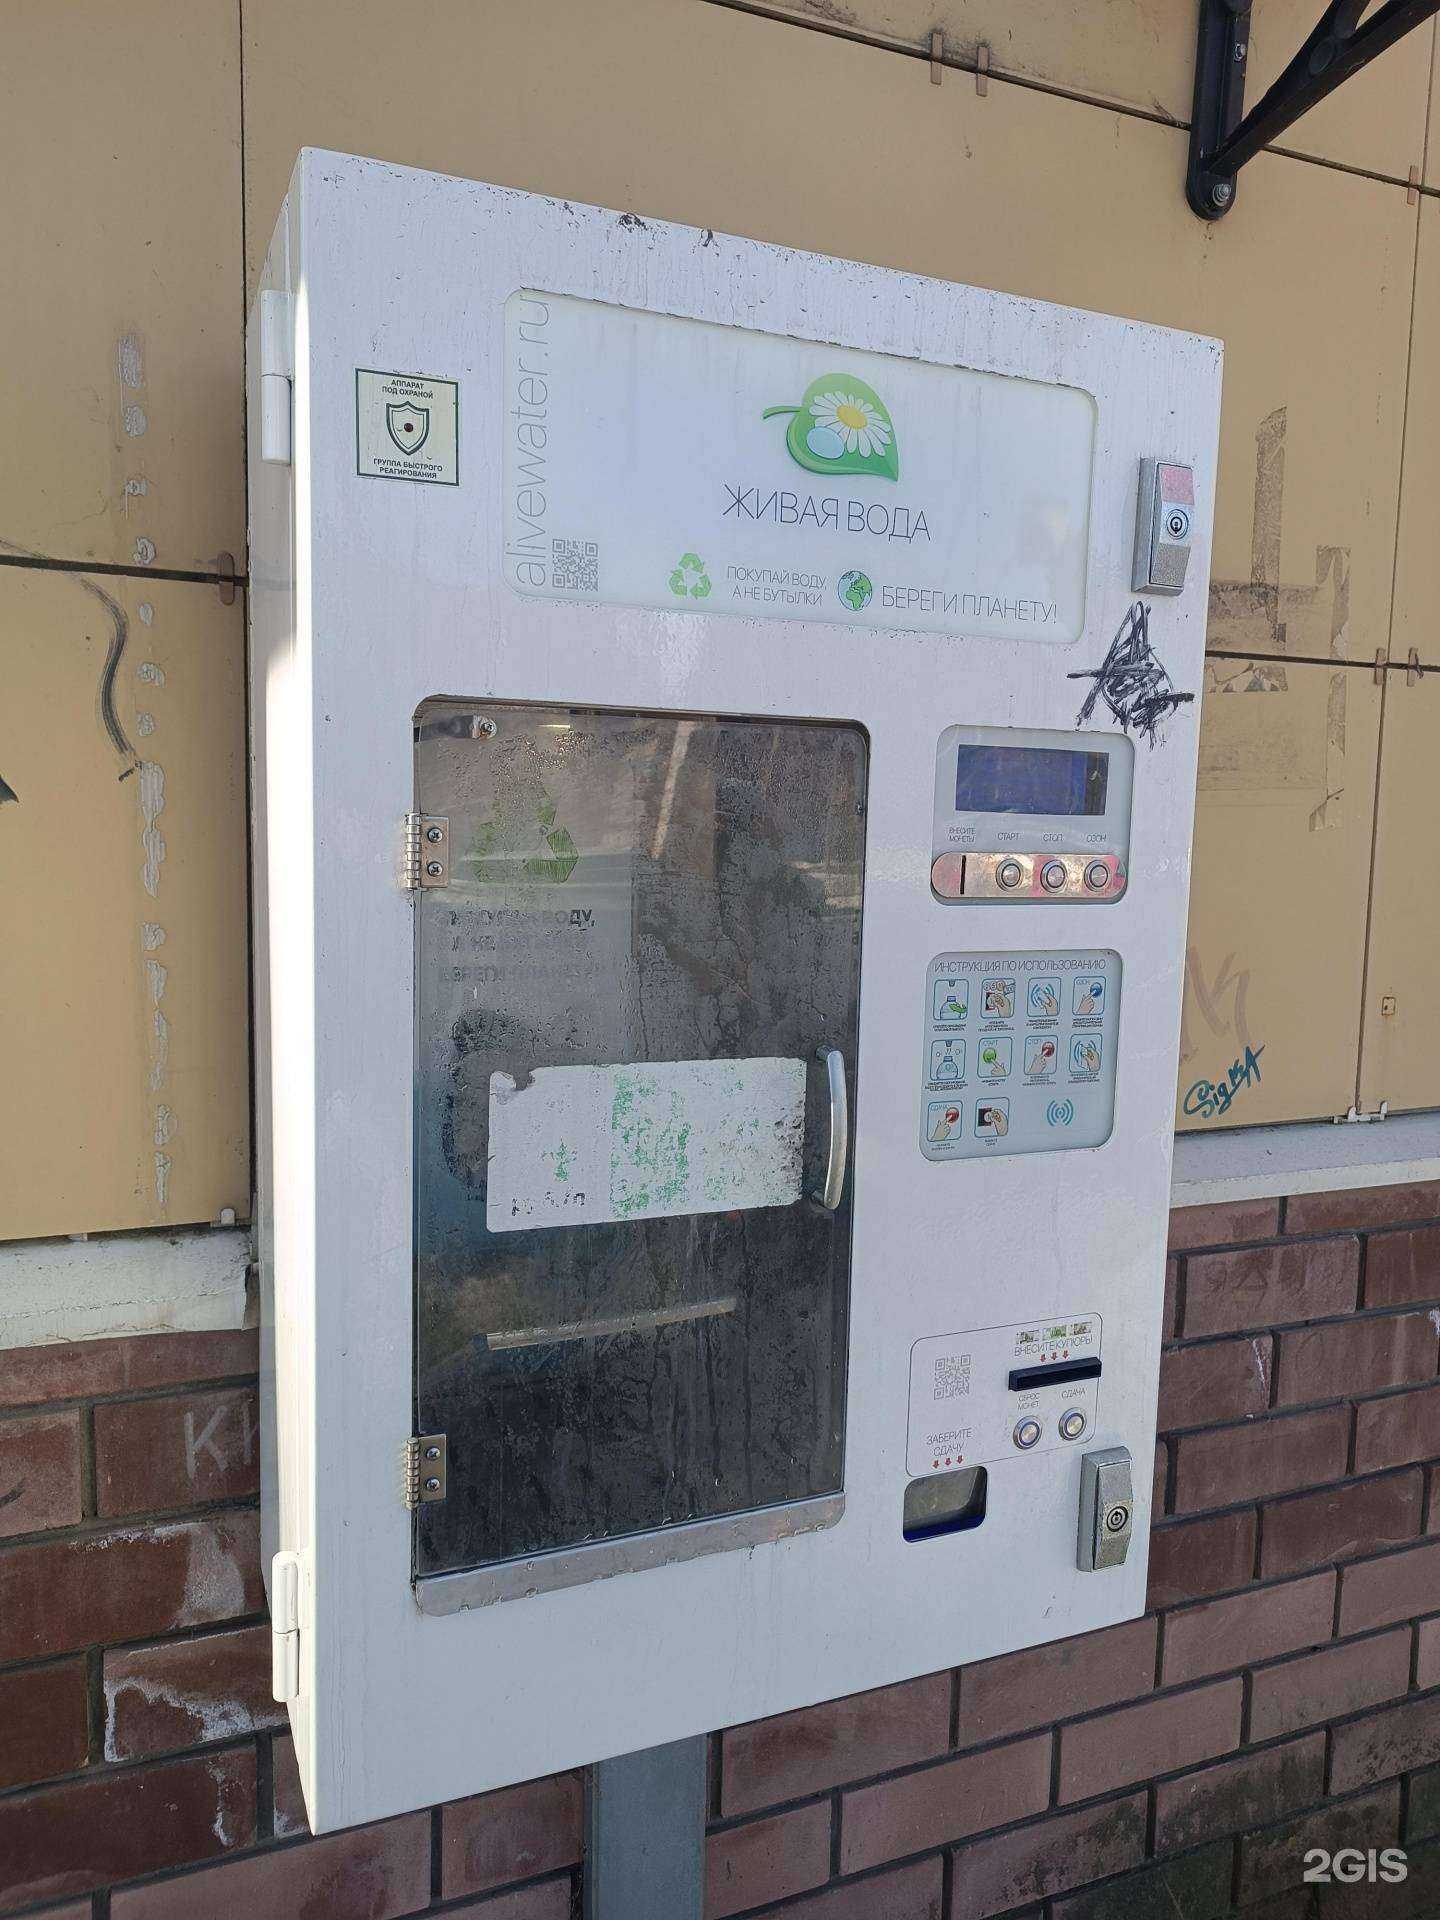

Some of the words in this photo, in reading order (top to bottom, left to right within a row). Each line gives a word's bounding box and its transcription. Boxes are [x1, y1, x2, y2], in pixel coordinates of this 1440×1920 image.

[391, 379, 424, 389] АППАРАТ
[382, 386, 398, 395] ПОД
[399, 388, 434, 399] ОХРАНОЙ
[505, 298, 549, 587] alivewater.ru
[373, 458, 402, 467] ГРУППА
[403, 461, 443, 472] БЫСТРОГО
[379, 467, 437, 479] РЕАГИРОВАНИЯ
[722, 482, 839, 530] ЖИВАЯ
[847, 501, 931, 544] ВОДА
[727, 565, 790, 584] ПОКУПАЙ
[792, 573, 827, 590] ВОДУ,
[732, 585, 742, 599] А
[744, 586, 760, 600] НЕ
[763, 587, 822, 606] БУТЫЛКИ
[882, 585, 958, 614] БЕРЕГИ
[962, 594, 1058, 624] ПЛАНЕТУ!
[997, 832, 1020, 841] СТАРТ
[934, 961, 1000, 973] ИНСТРУКЦИЯ
[1002, 960, 1017, 972] ПО
[1018, 959, 1107, 971] ИСПОЛЬЗОВАНИЮ
[1014, 1340, 1056, 1357] ВНЕСИТЕ
[1056, 1334, 1093, 1349] КУПЮРЫ
[1061, 1387, 1087, 1399] СДАЧА
[926, 1427, 972, 1445] ЗАБЕРИТЕ
[933, 1441, 965, 1456] СДАЧУ
